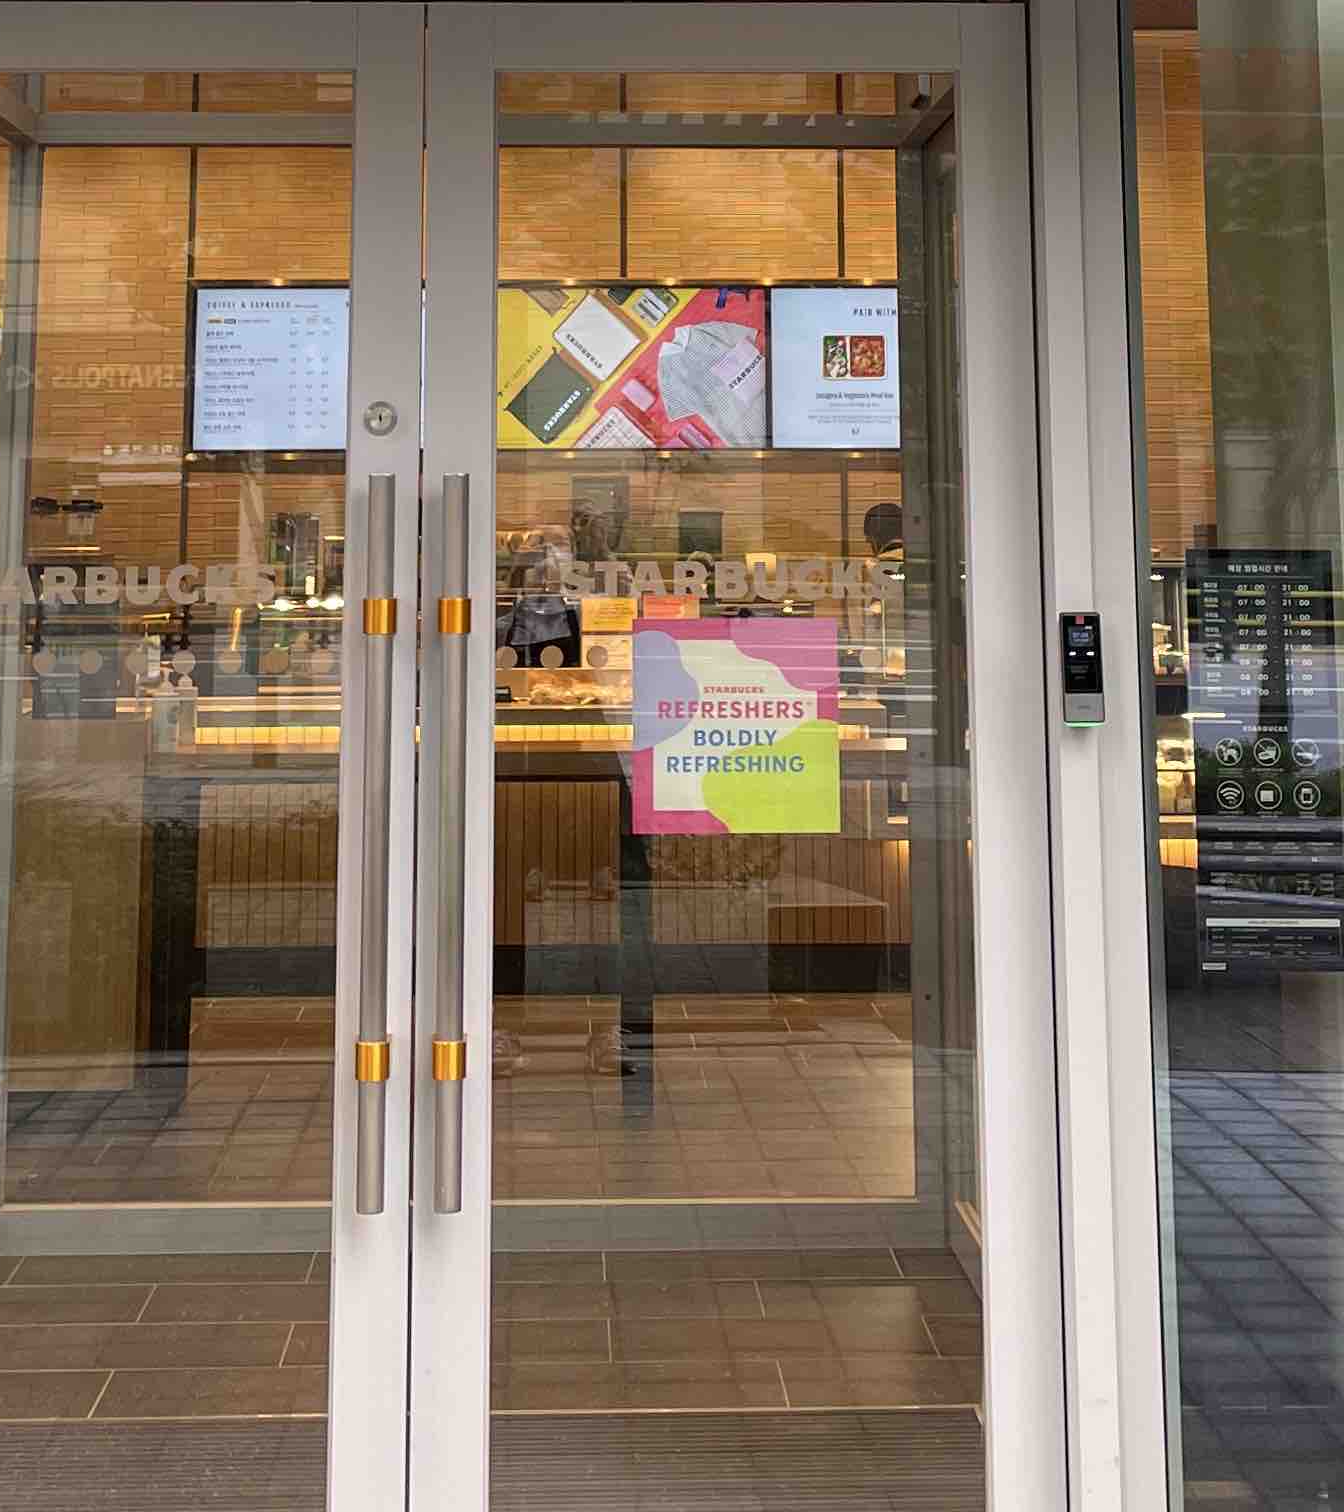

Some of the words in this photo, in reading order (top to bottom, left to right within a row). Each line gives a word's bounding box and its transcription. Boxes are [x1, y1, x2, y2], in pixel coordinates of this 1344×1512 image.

[560, 560, 904, 600] STARBUCKS
[703, 686, 765, 694] STARBUCKS
[693, 729, 778, 747] BOLDLY
[666, 756, 805, 774] REFRESHING
